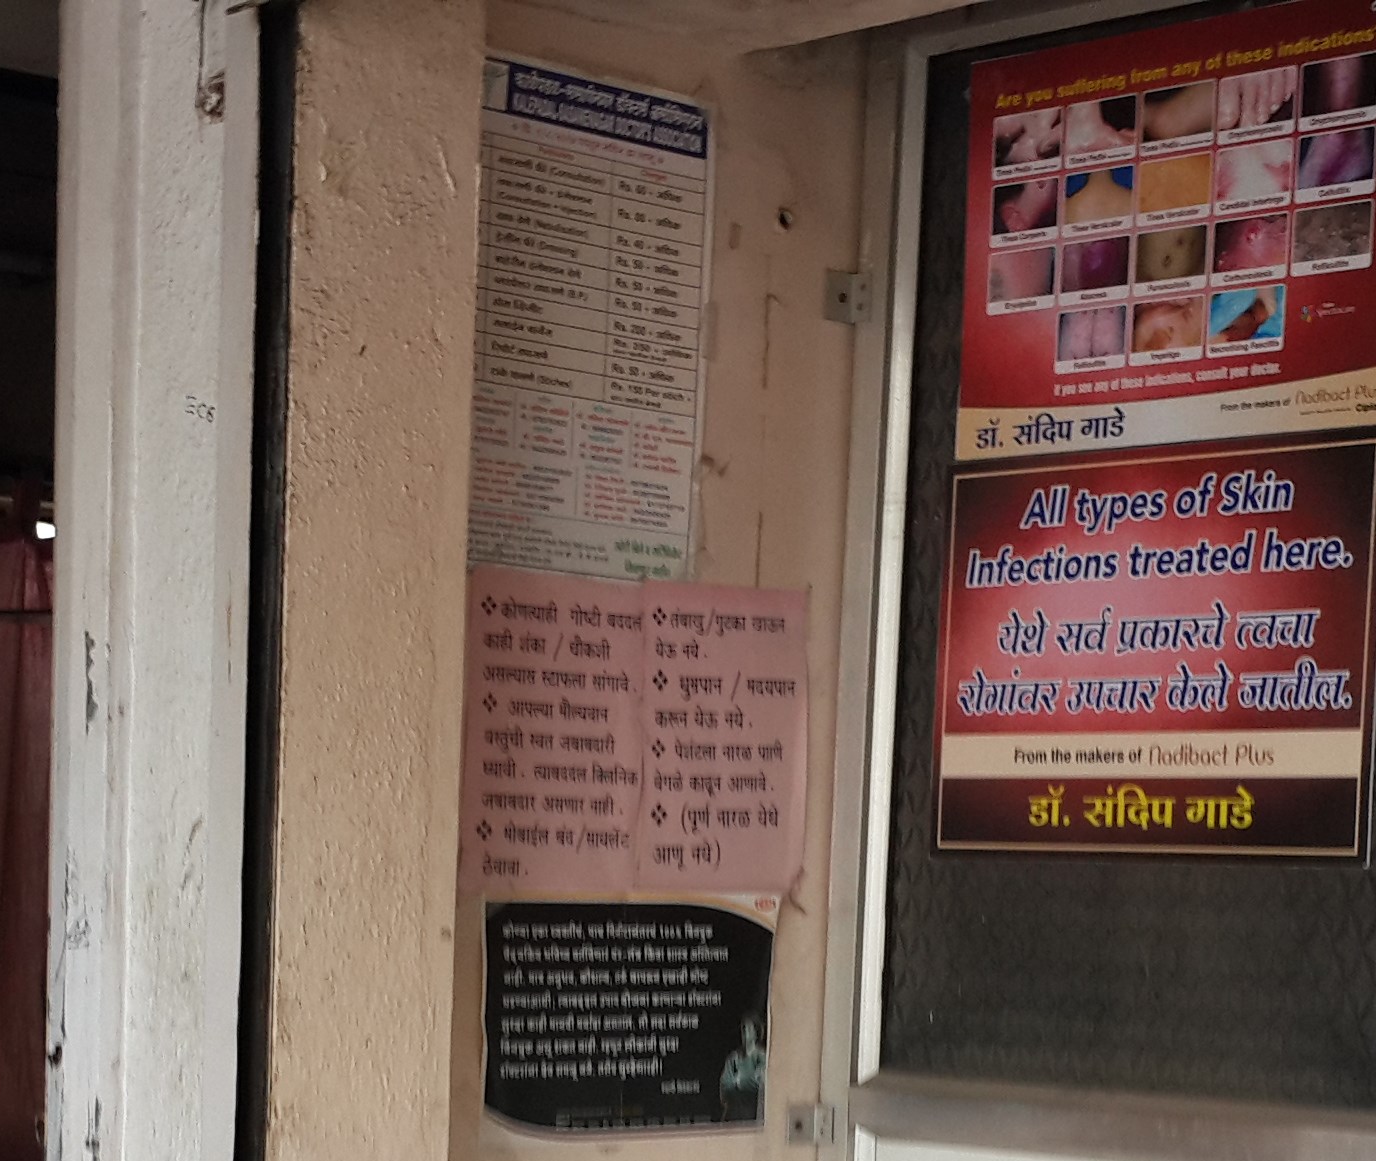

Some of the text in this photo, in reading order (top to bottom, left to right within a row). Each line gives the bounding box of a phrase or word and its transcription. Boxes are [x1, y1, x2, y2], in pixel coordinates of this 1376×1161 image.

[996, 92, 1023, 109] Are
[1027, 89, 1053, 107] you
[1057, 74, 1125, 98] suffering
[1130, 68, 1168, 86] from
[1171, 60, 1201, 80] any
[1204, 56, 1222, 73] of
[1226, 45, 1272, 68] these
[1081, 407, 1125, 441] गाडे
[1020, 470, 1295, 535] All types of Skin
[966, 527, 1353, 588] Infections treated here.
[998, 600, 1321, 658] येथे सर्व प्रकारचे त्वचा
[958, 656, 1352, 717] रोगांवर उपचार केले जातील.
[1014, 747, 1047, 765] From
[1050, 747, 1071, 764] the
[1075, 747, 1124, 765] makers
[1128, 747, 1142, 764] of
[1235, 744, 1274, 766] Plus
[1083, 783, 1175, 830] संदिप
[1185, 785, 1254, 830] गाडे
